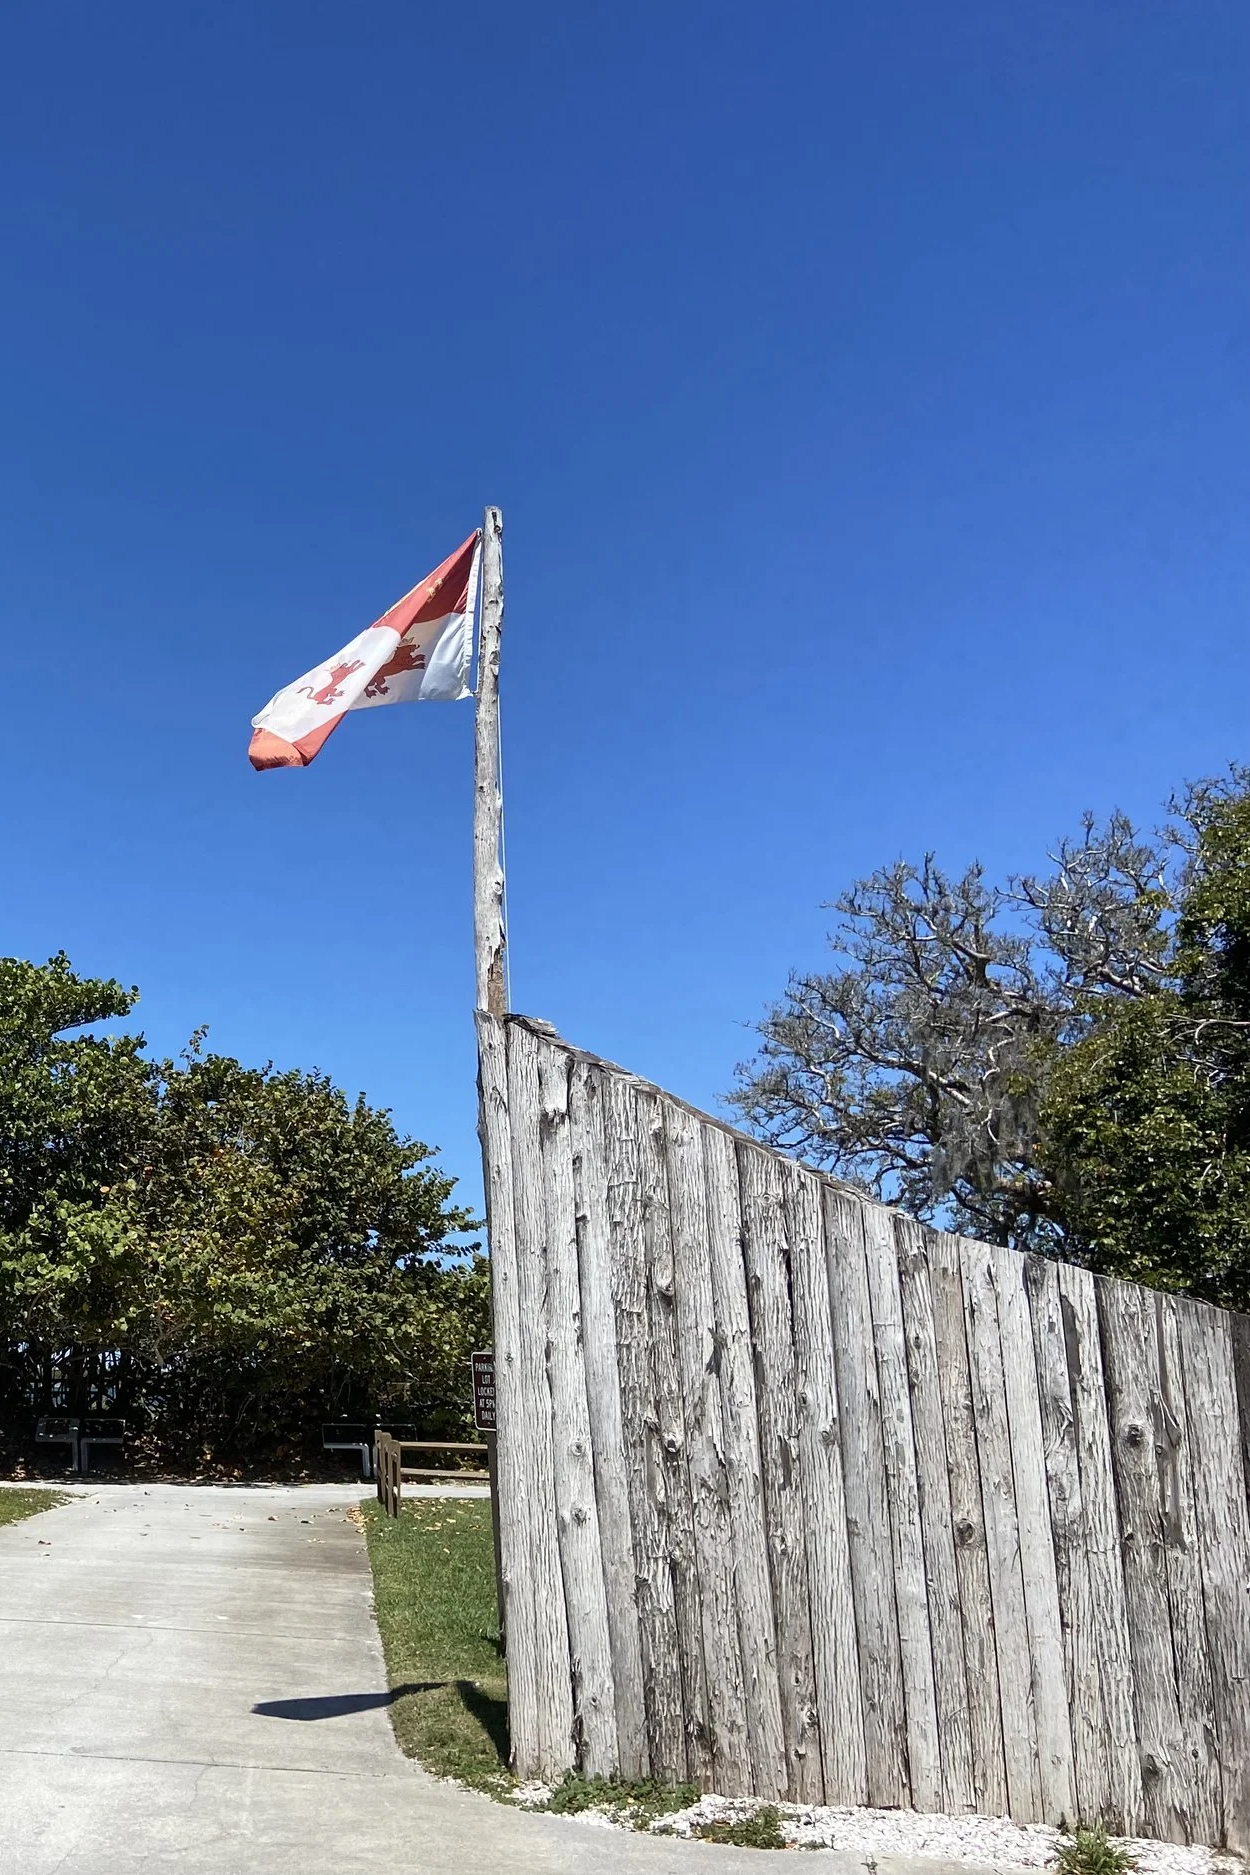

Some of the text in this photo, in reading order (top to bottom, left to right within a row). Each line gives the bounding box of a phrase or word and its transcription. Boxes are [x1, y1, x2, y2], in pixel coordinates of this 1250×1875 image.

[481, 1374, 491, 1384] LOT
[479, 1398, 485, 1408] AT
[481, 1410, 495, 1420] DAILY
